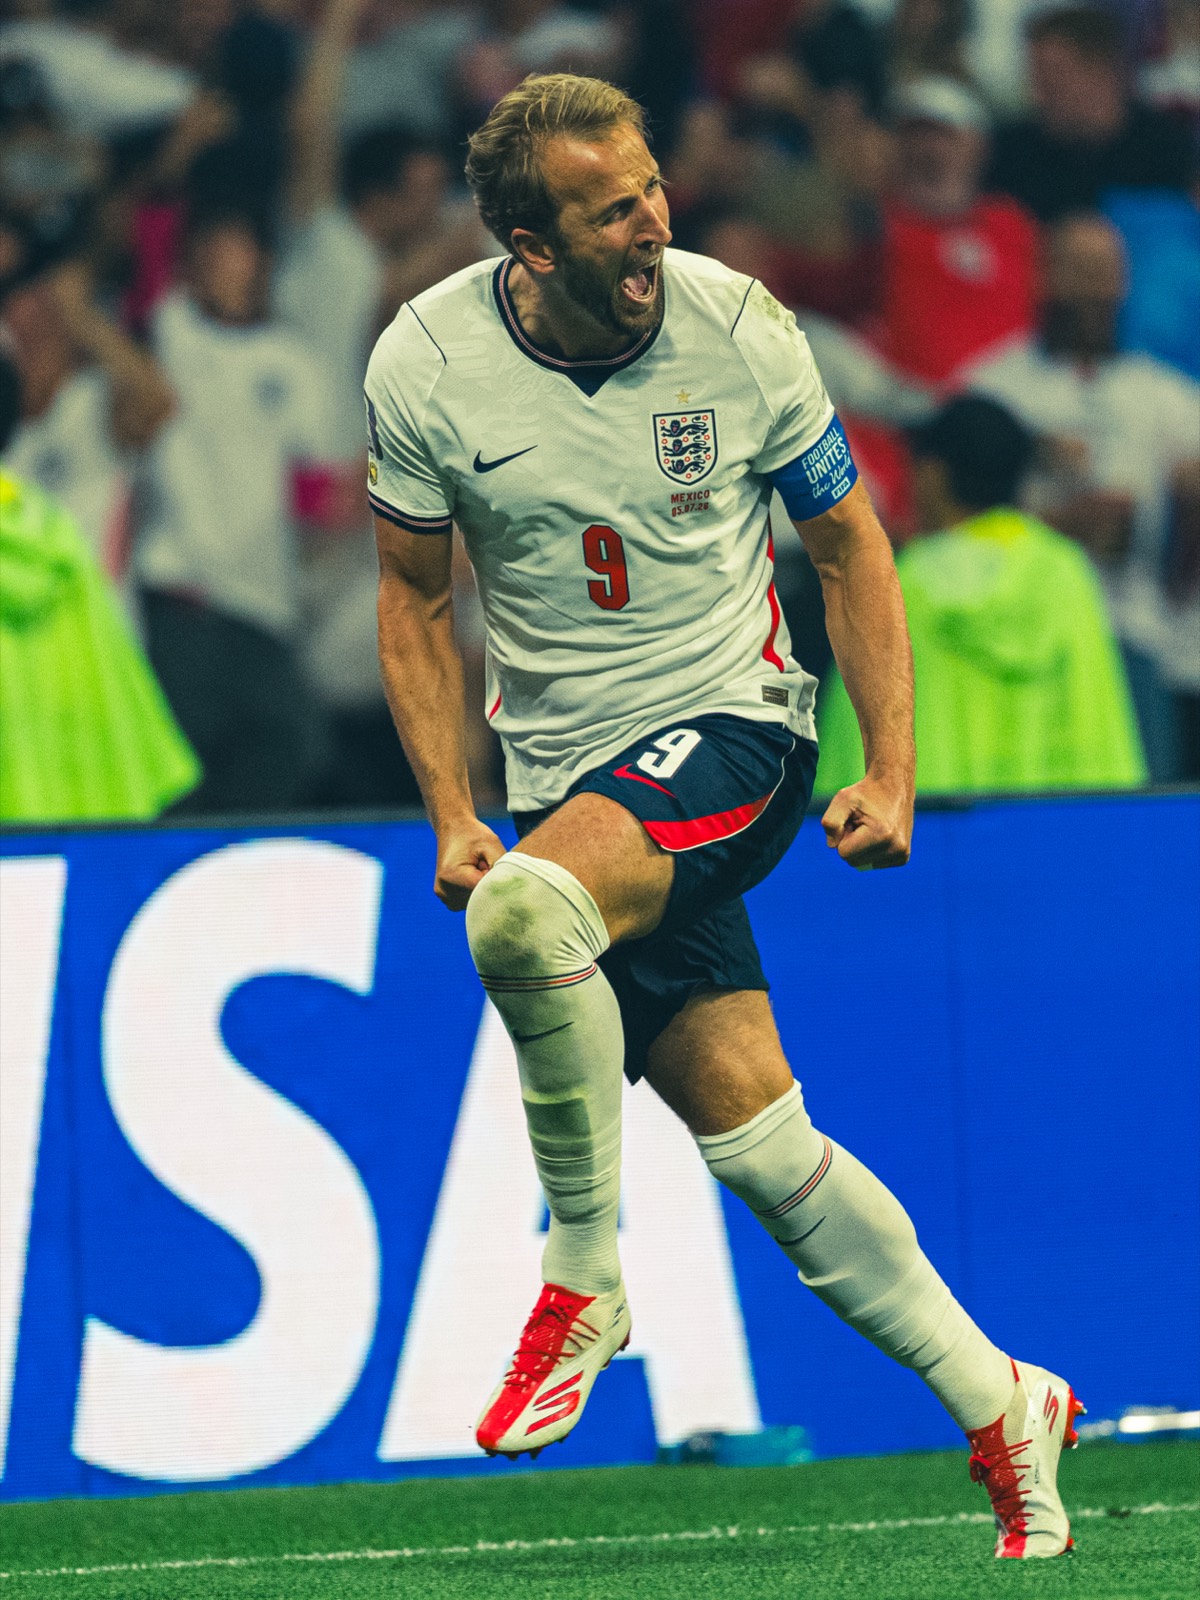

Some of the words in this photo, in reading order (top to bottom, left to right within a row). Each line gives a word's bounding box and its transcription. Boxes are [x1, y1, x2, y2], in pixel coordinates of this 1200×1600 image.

[801, 427, 840, 470] FOOTBALL
[806, 436, 847, 484] UNITES
[671, 489, 710, 504] MEXICO
[671, 502, 709, 517] 05.07.26
[812, 482, 831, 499] the
[582, 524, 630, 611] 9
[636, 728, 703, 778] 9
